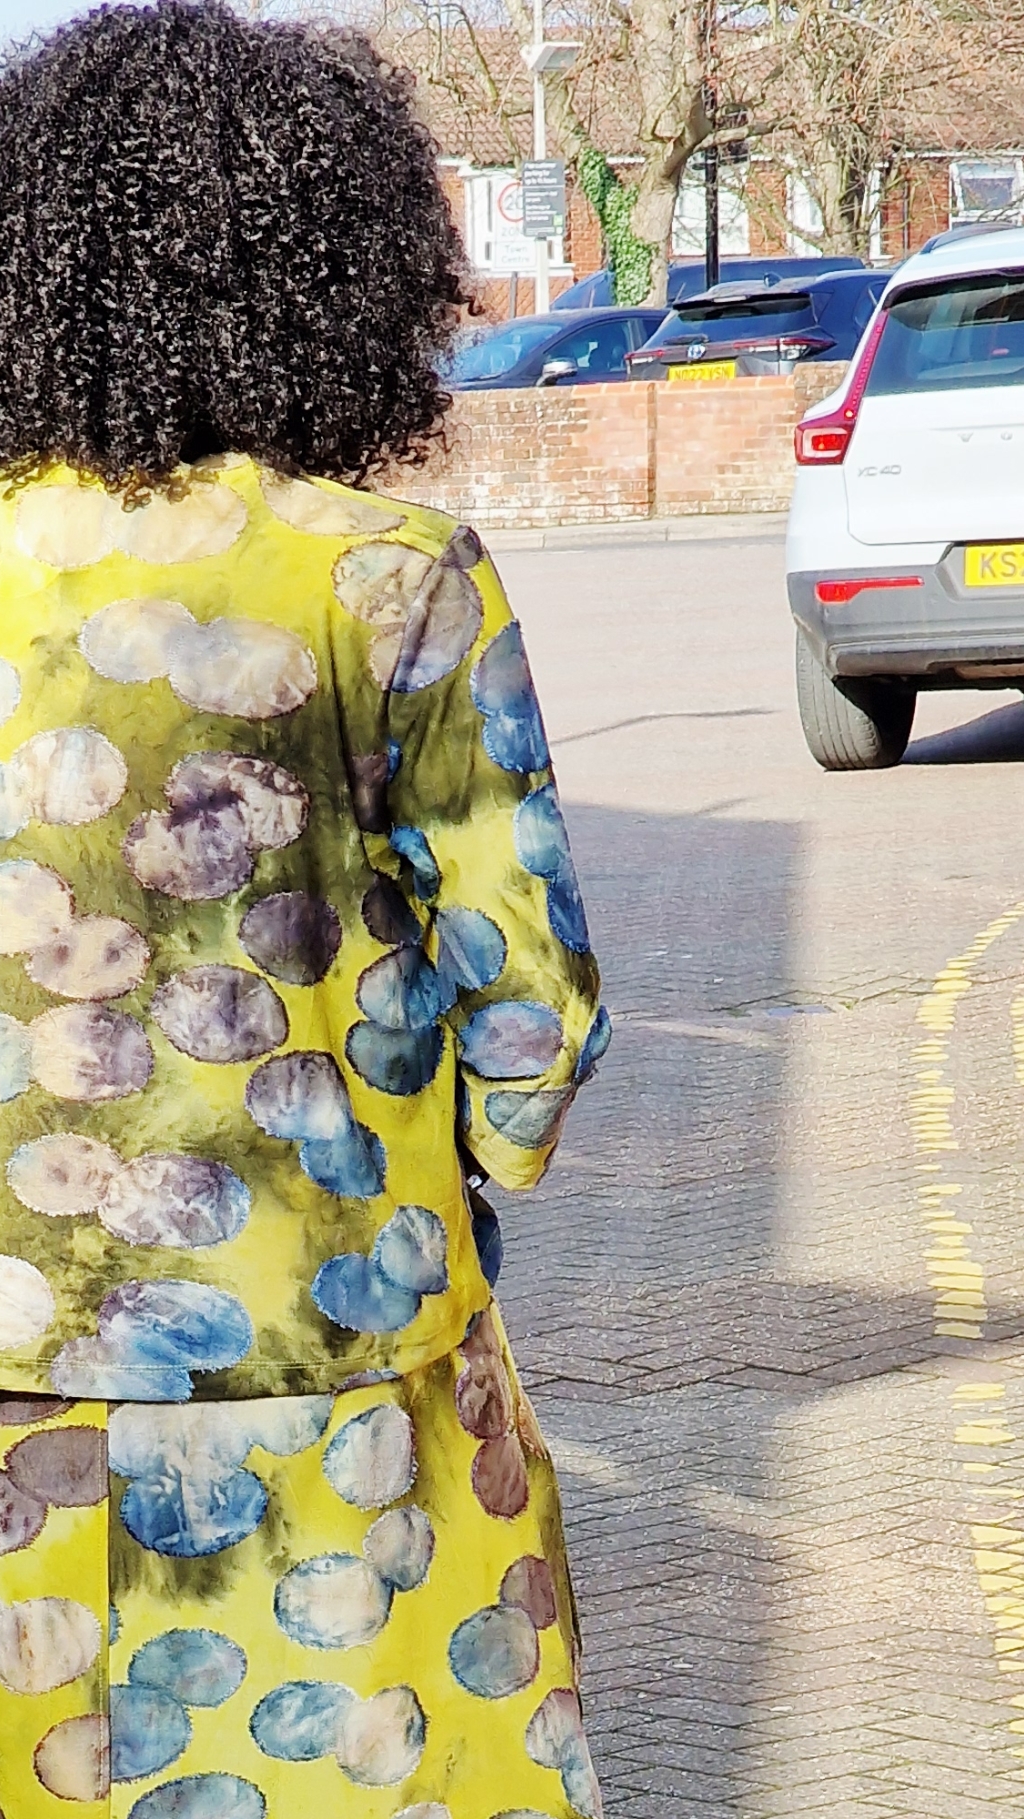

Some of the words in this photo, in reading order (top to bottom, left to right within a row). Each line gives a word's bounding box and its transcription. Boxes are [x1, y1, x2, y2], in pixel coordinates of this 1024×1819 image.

[504, 244, 528, 253] Town
[501, 255, 530, 264] Centre
[980, 550, 1024, 579] KS
